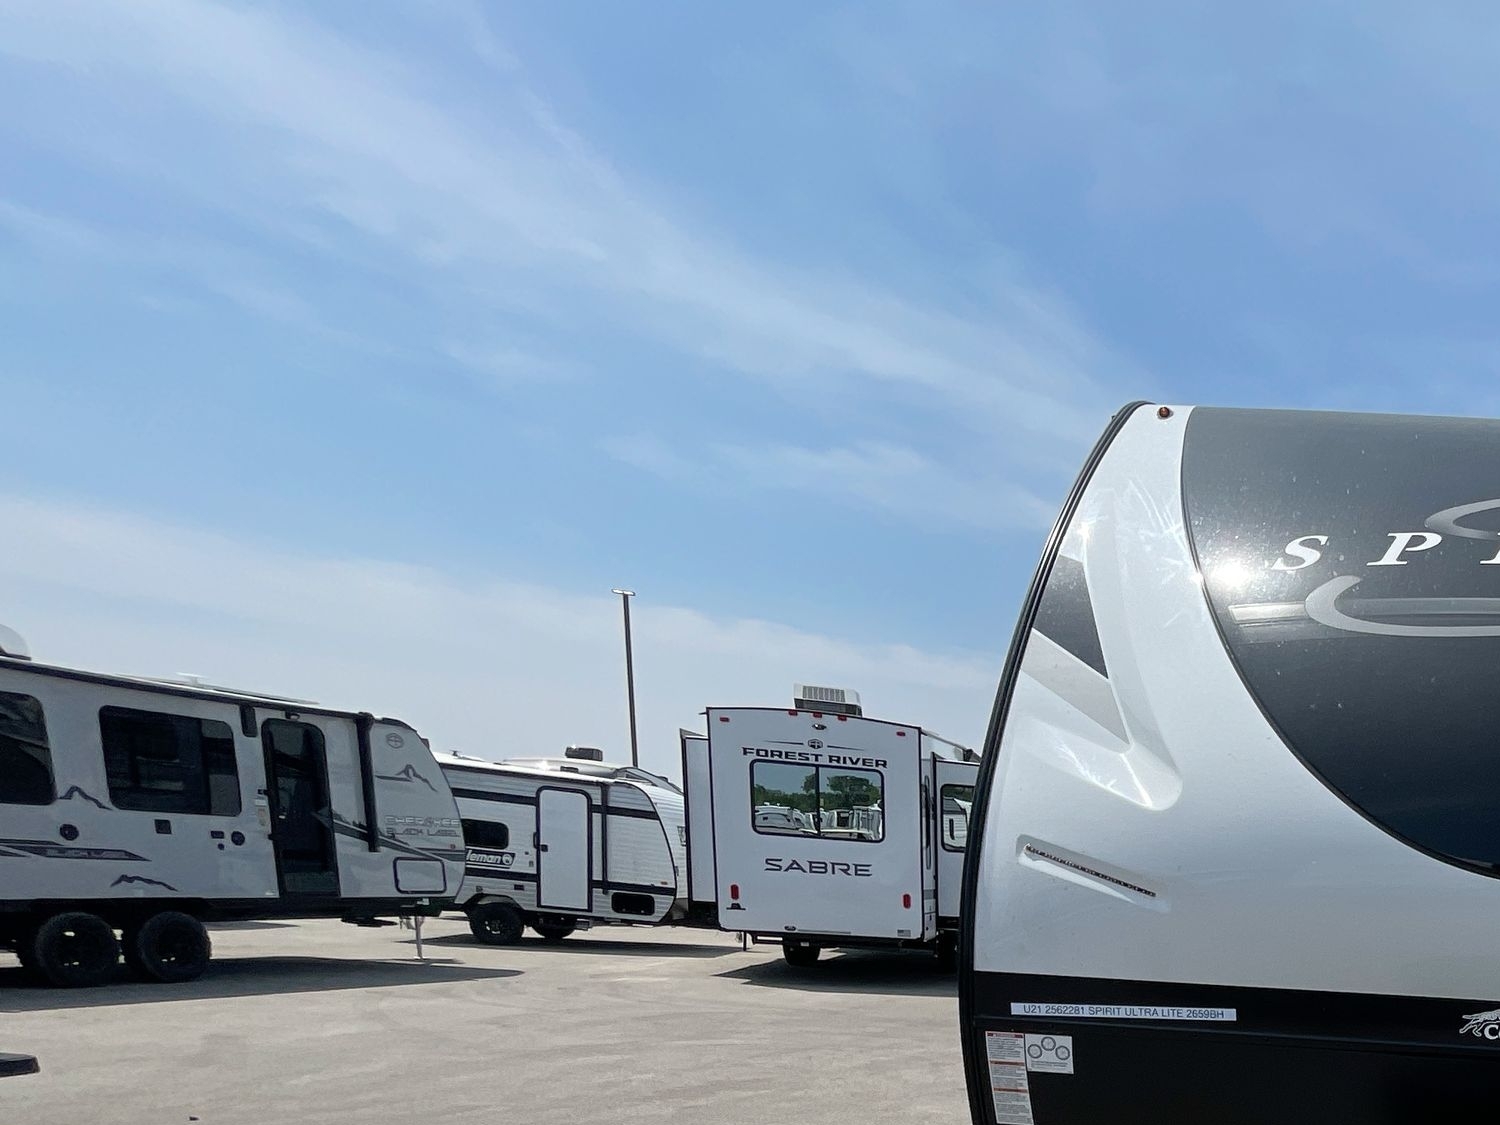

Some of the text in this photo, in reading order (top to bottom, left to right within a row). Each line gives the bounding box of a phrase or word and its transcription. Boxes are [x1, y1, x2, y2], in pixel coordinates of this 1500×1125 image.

[742, 747, 888, 769] FOREST RIVER
[764, 858, 873, 877] SABRE
[1023, 1004, 1225, 1019] U21 2562281 SPIRIT ULTRA LITE 2659BH
